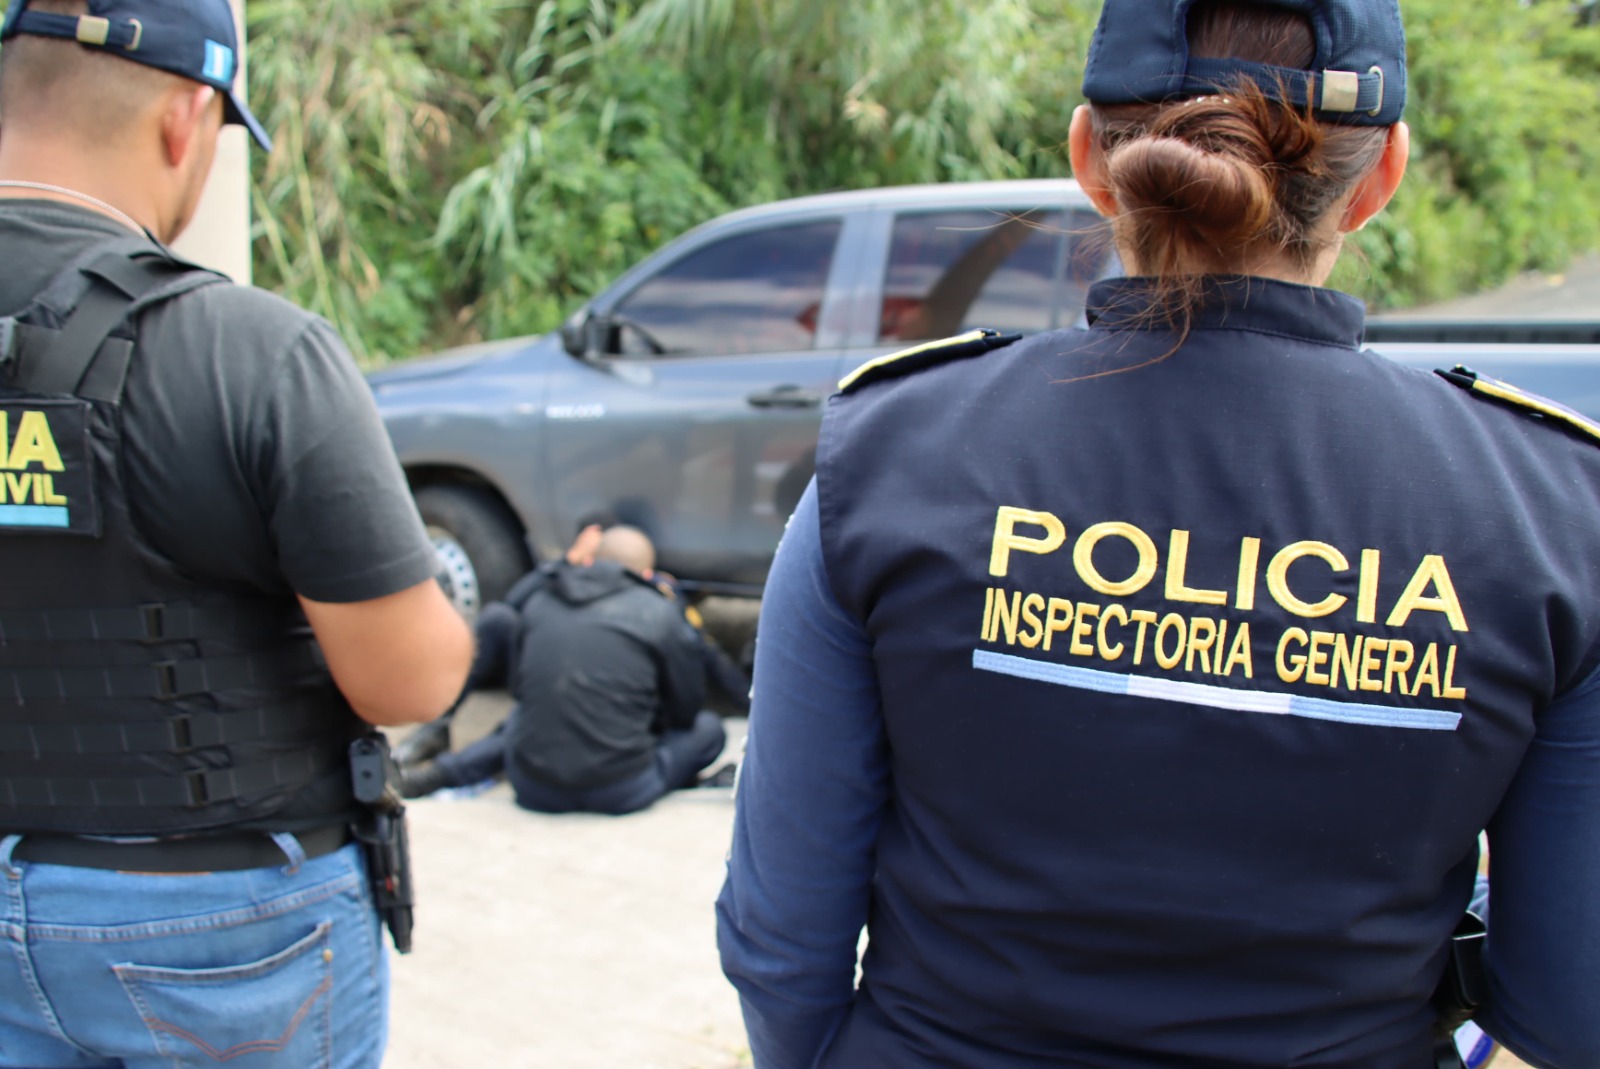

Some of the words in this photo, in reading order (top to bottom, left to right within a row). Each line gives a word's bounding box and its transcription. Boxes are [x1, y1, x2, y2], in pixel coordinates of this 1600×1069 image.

[988, 505, 1469, 632] POLICIA
[980, 587, 1253, 678] INSPECTORIA
[1275, 627, 1466, 699] GENERAL
